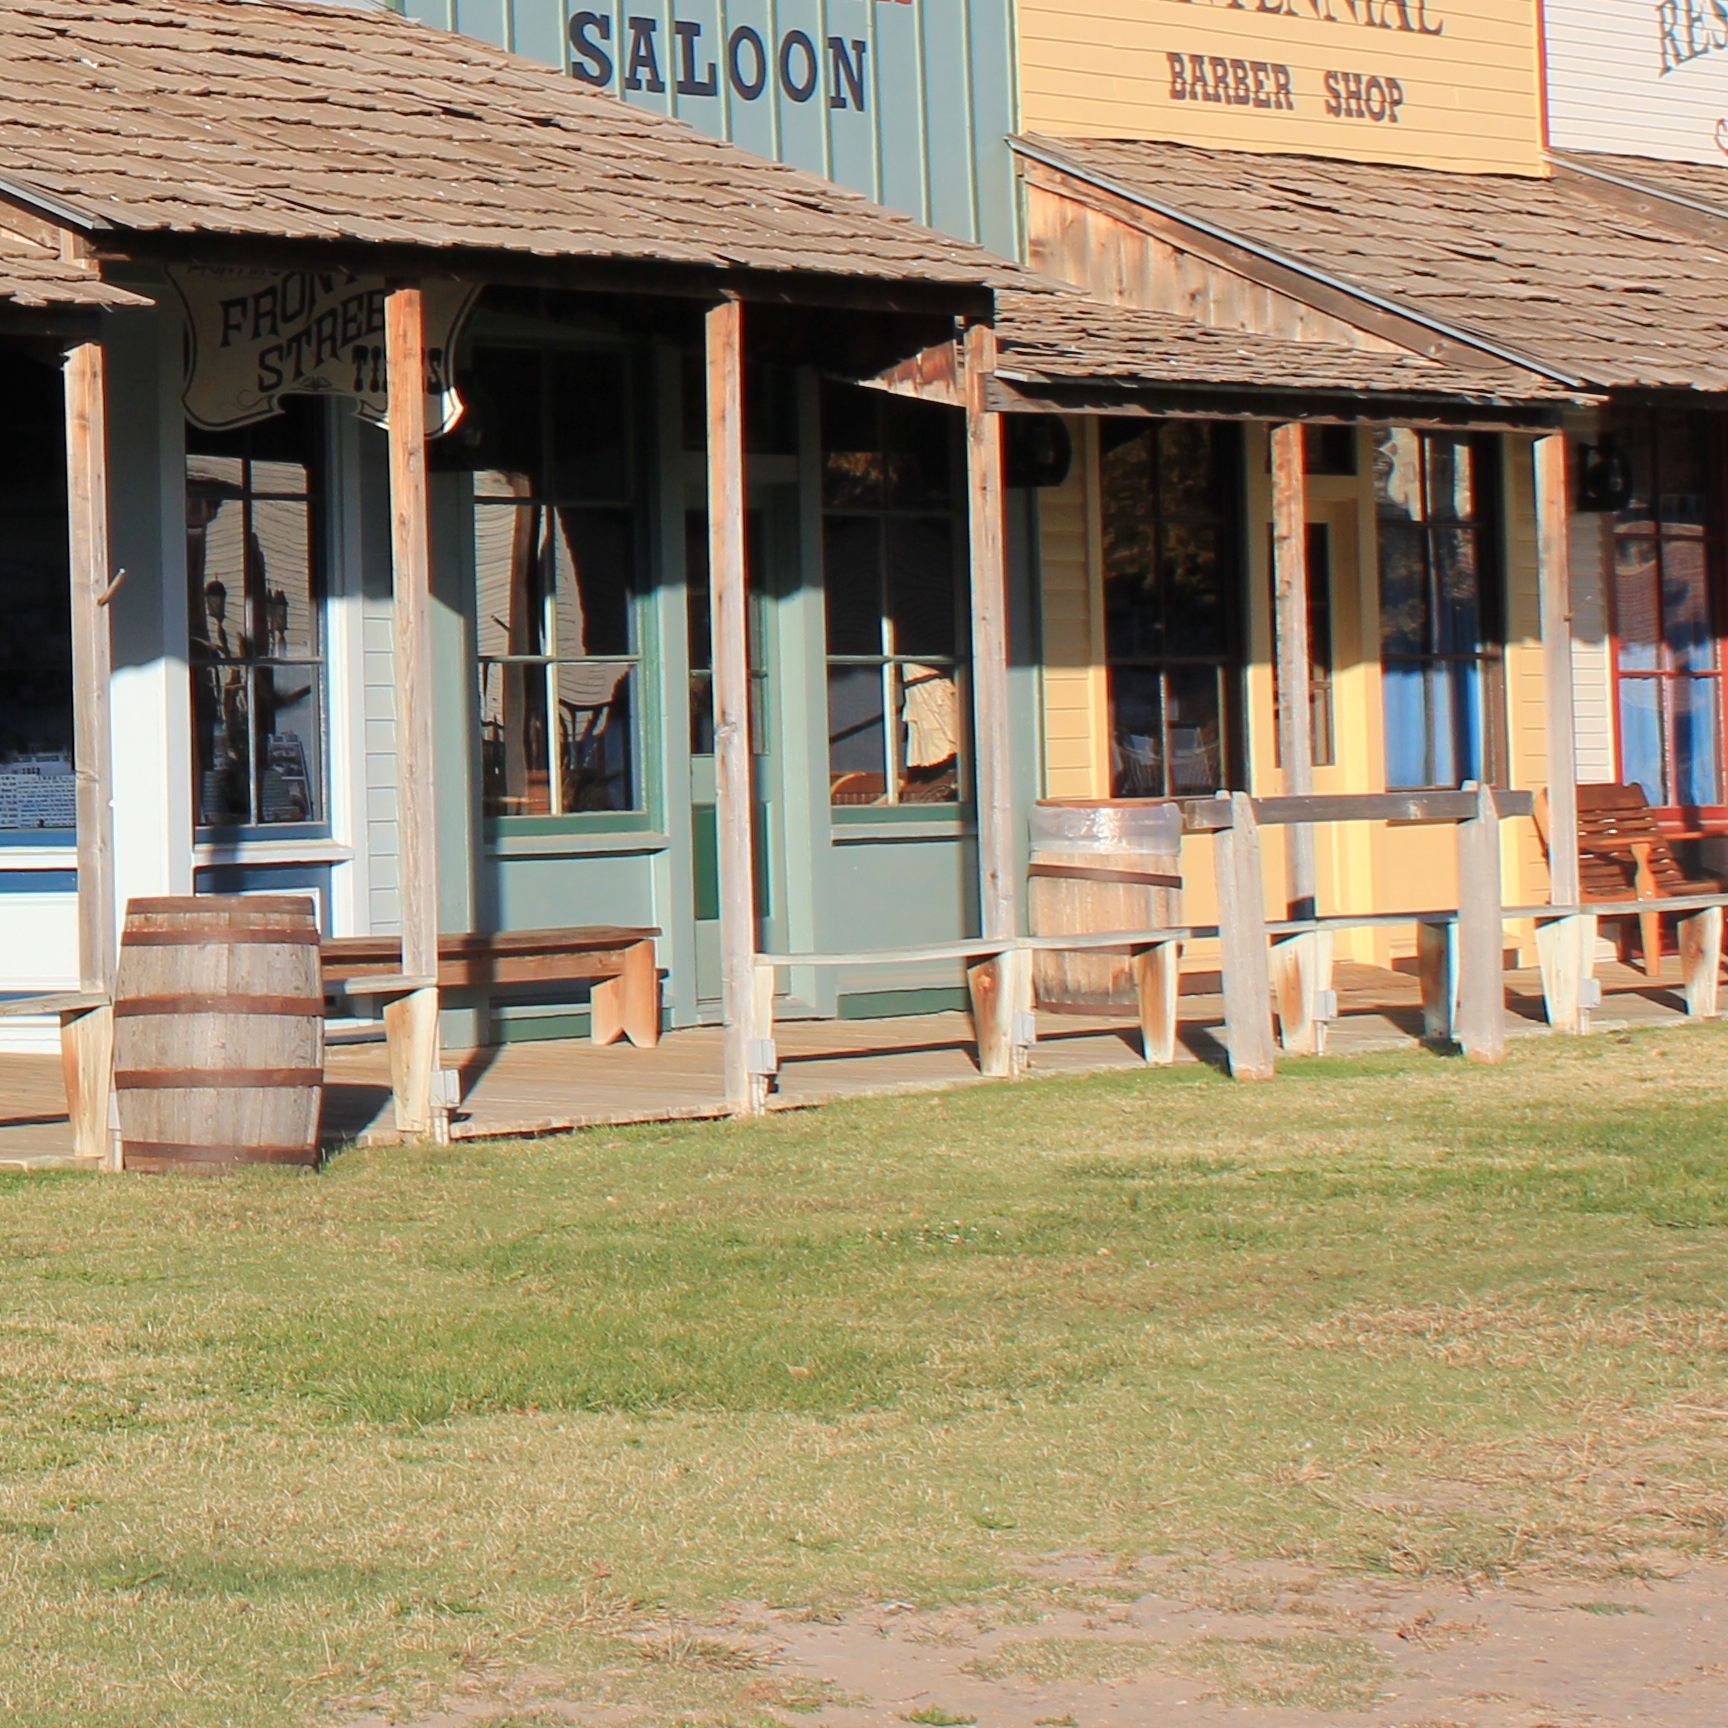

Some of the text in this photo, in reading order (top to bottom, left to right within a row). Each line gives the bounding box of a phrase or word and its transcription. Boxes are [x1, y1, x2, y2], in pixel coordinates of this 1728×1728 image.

[568, 10, 866, 111] SALOON
[1166, 52, 1404, 123] BARBER SHOP
[218, 271, 358, 349] FRON
[257, 288, 386, 393] STREE
[352, 344, 443, 395] TIS
